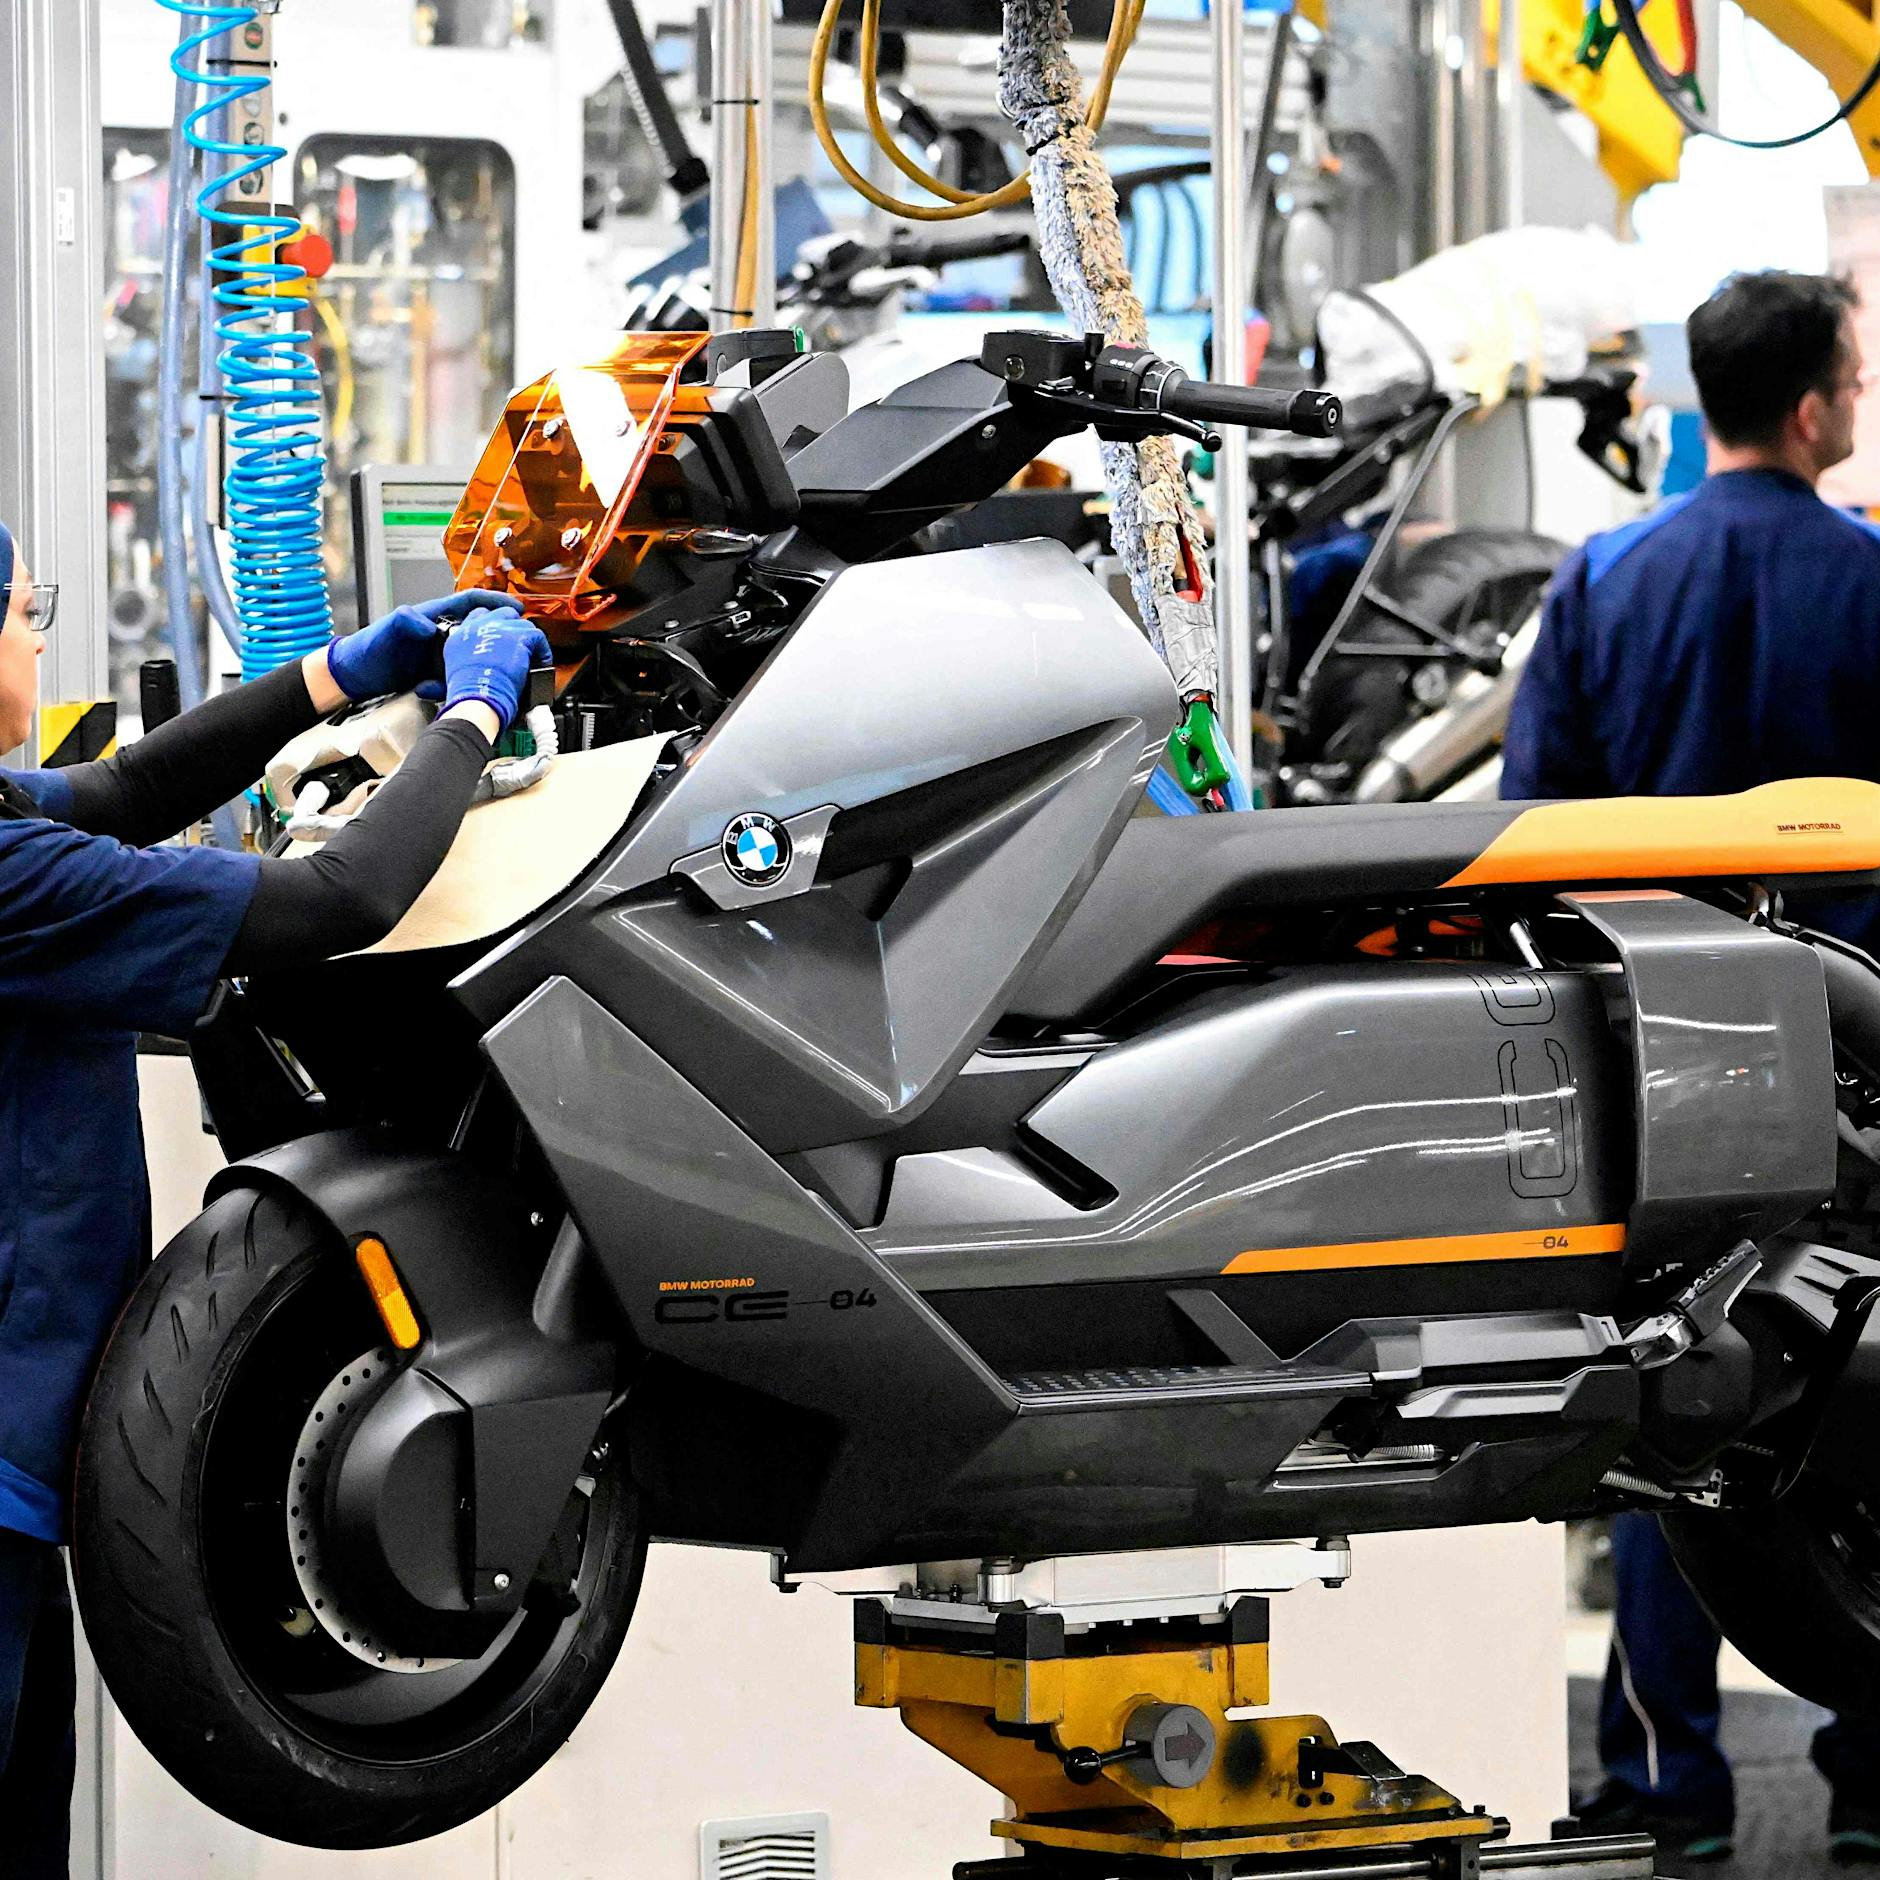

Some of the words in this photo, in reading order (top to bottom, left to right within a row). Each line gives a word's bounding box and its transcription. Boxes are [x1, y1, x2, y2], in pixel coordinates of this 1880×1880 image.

[726, 815, 779, 845] BMW
[1777, 824, 1796, 832] BMW
[1797, 822, 1841, 831] MOTORRAD
[659, 1280, 689, 1291] BMW
[690, 1278, 755, 1290] MOTORRAD
